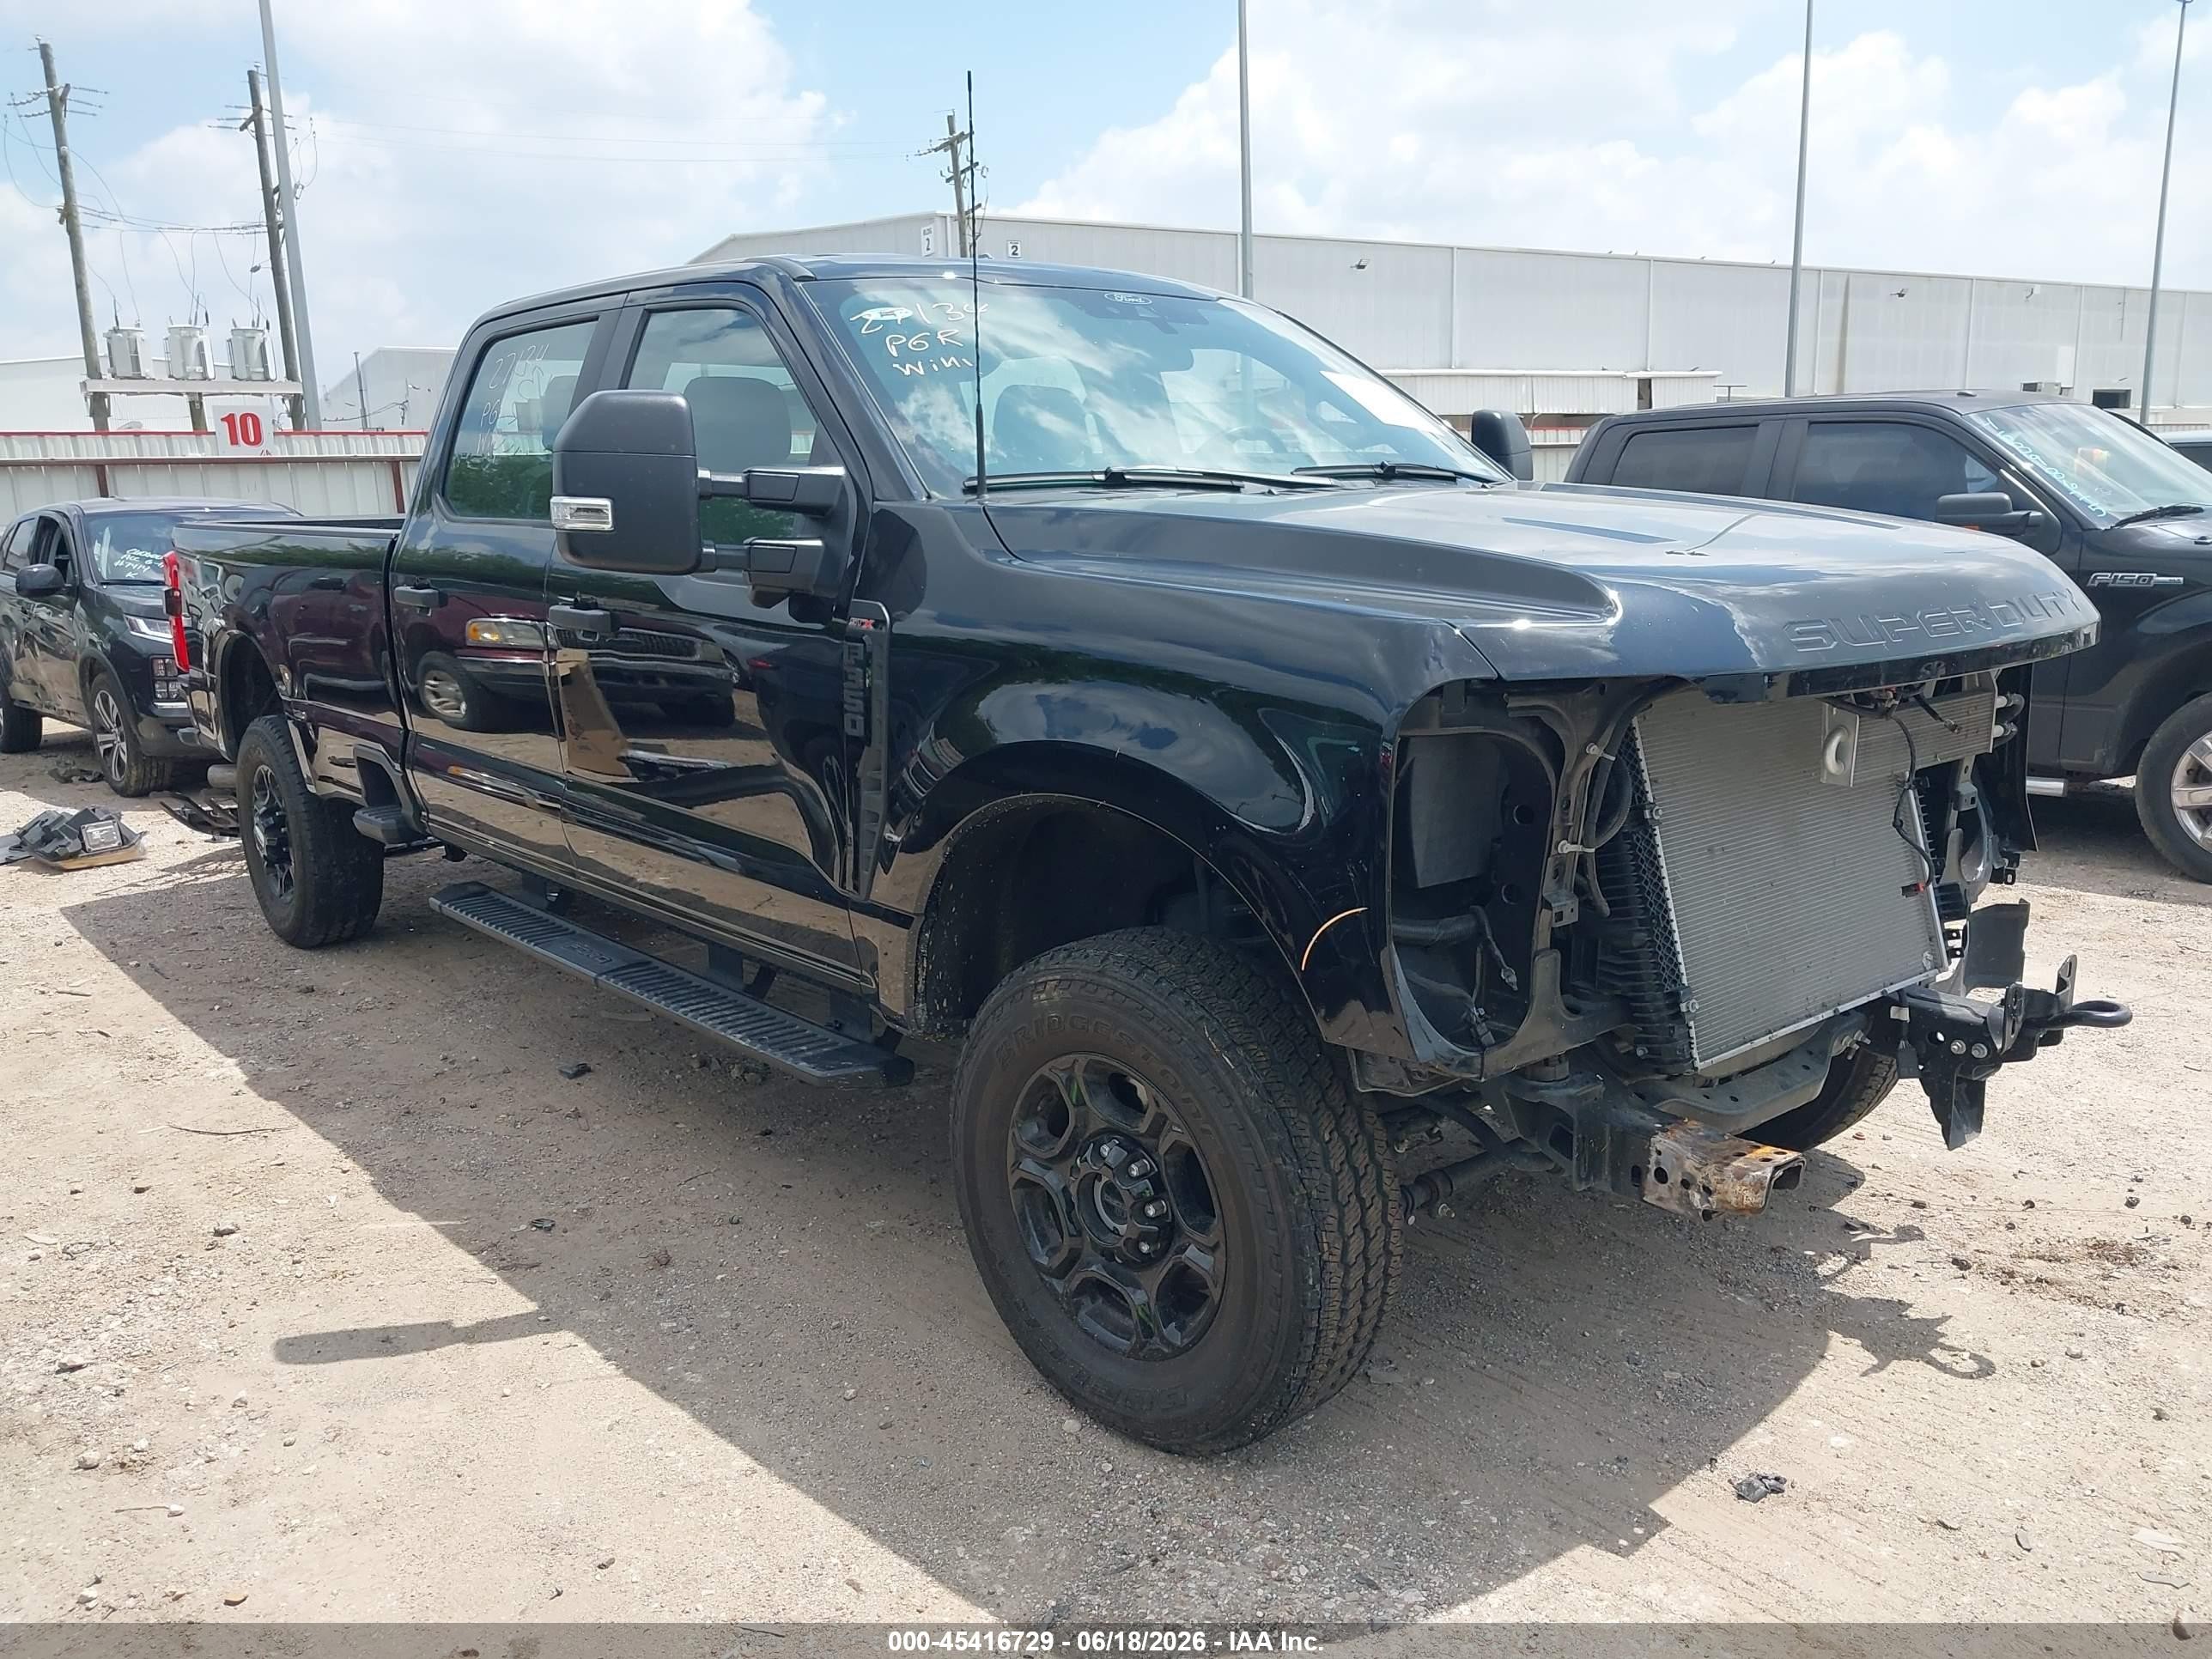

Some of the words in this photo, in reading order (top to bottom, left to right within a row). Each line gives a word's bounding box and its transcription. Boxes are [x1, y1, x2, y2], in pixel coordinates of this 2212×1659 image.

[1011, 245, 1019, 256] 2
[220, 412, 263, 447] 10
[1783, 603, 1992, 653] SUPER
[1986, 588, 2081, 628] DUTY
[995, 1013, 1220, 1150] BRIDGESTONE
